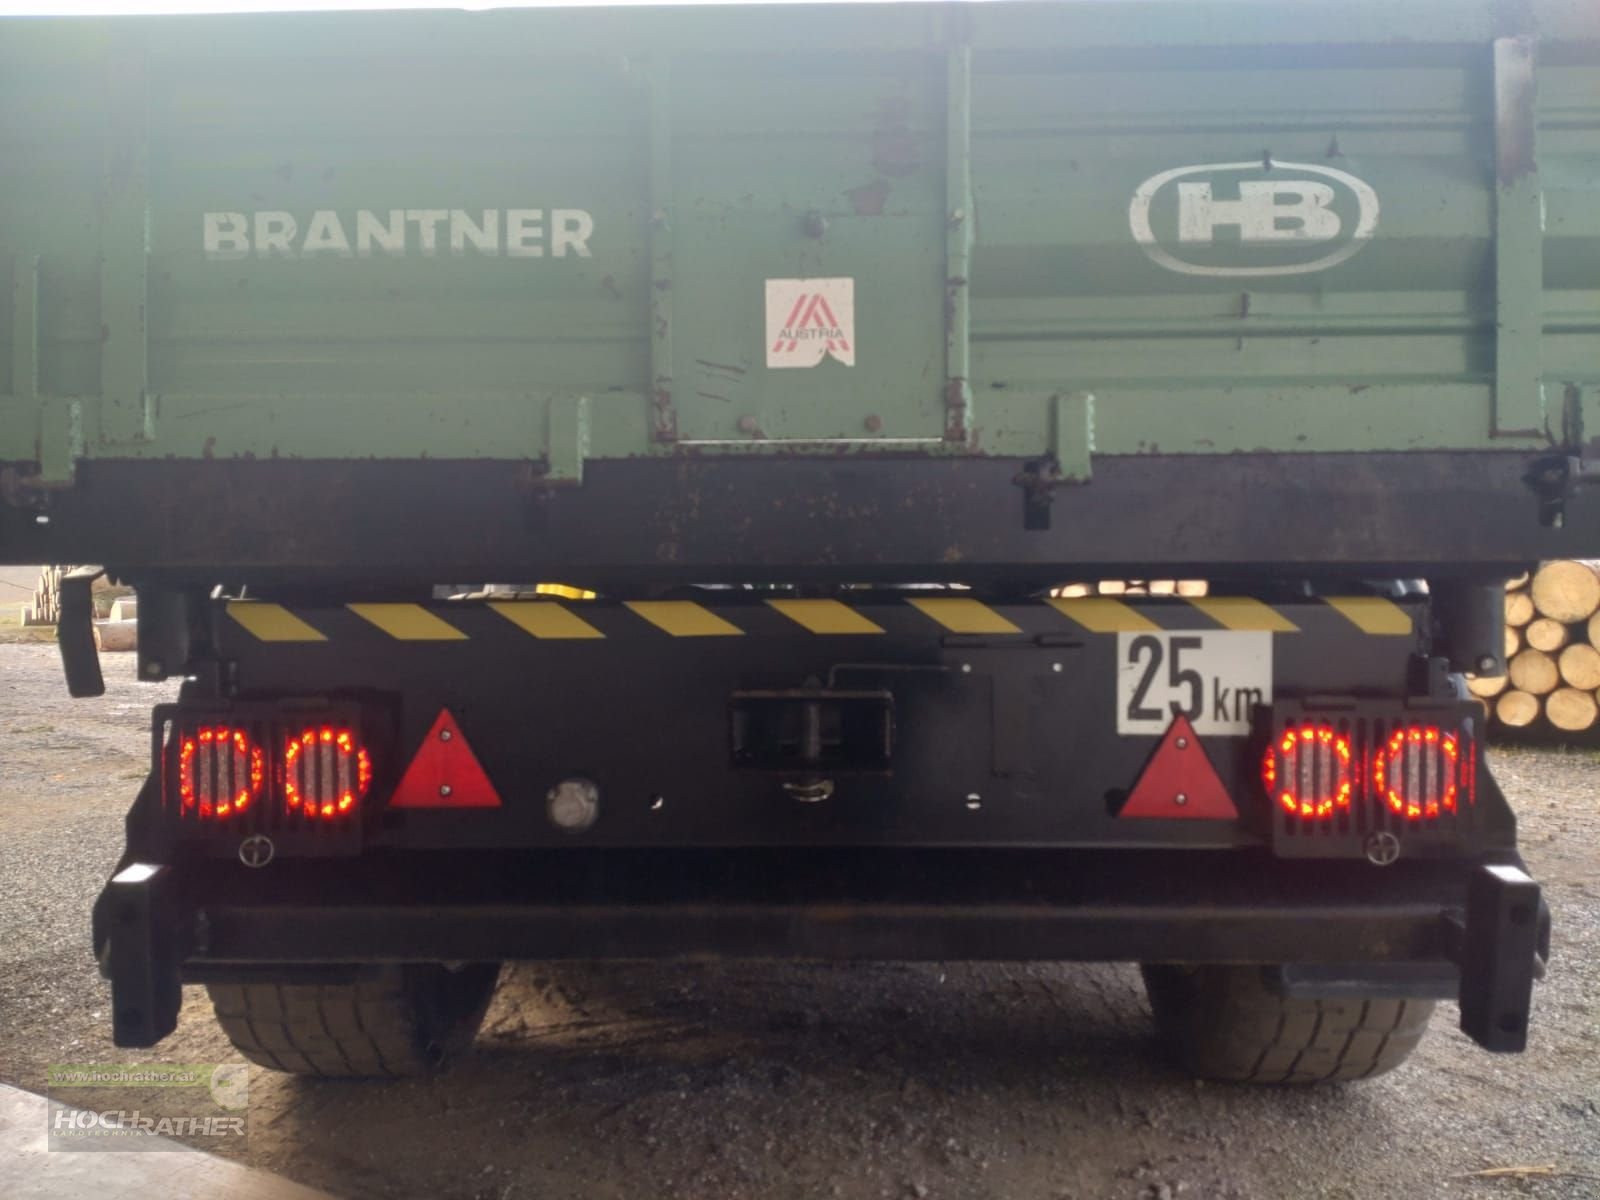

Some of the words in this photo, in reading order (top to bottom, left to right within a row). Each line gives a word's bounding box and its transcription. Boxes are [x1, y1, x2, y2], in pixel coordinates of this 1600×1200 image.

[203, 208, 594, 260] BRANTNER
[1178, 180, 1342, 244] HB
[779, 327, 844, 339] AUSTRIA
[1127, 635, 1204, 722] 25
[1213, 677, 1263, 722] km
